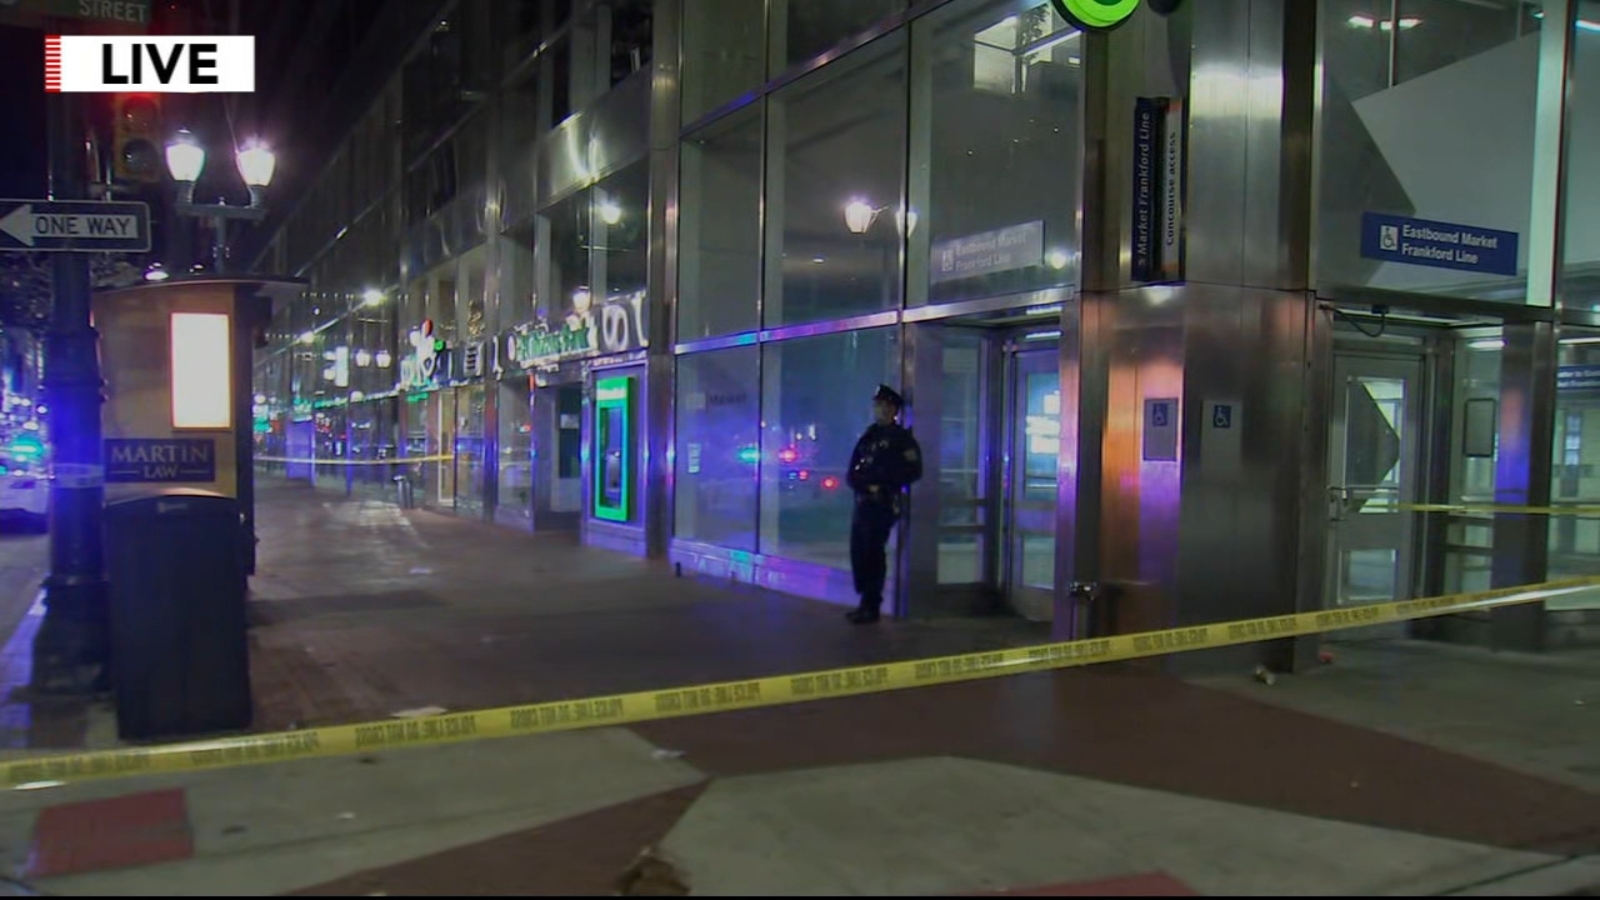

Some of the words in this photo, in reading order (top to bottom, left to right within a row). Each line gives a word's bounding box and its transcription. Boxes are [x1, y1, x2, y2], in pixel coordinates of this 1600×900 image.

[79, 0, 148, 22] STREET
[1139, 112, 1150, 139] Line
[1138, 144, 1149, 206] Frankford
[1166, 179, 1175, 246] Concourse
[35, 215, 79, 235] ONE
[86, 216, 130, 236] WAY
[1137, 209, 1148, 255] Market
[1402, 224, 1459, 244] Eastbound
[1461, 232, 1498, 249] Market
[1402, 243, 1452, 261] Frankford
[1455, 252, 1479, 264] Line
[110, 445, 208, 463] MARTIN
[143, 464, 179, 480] LAW
